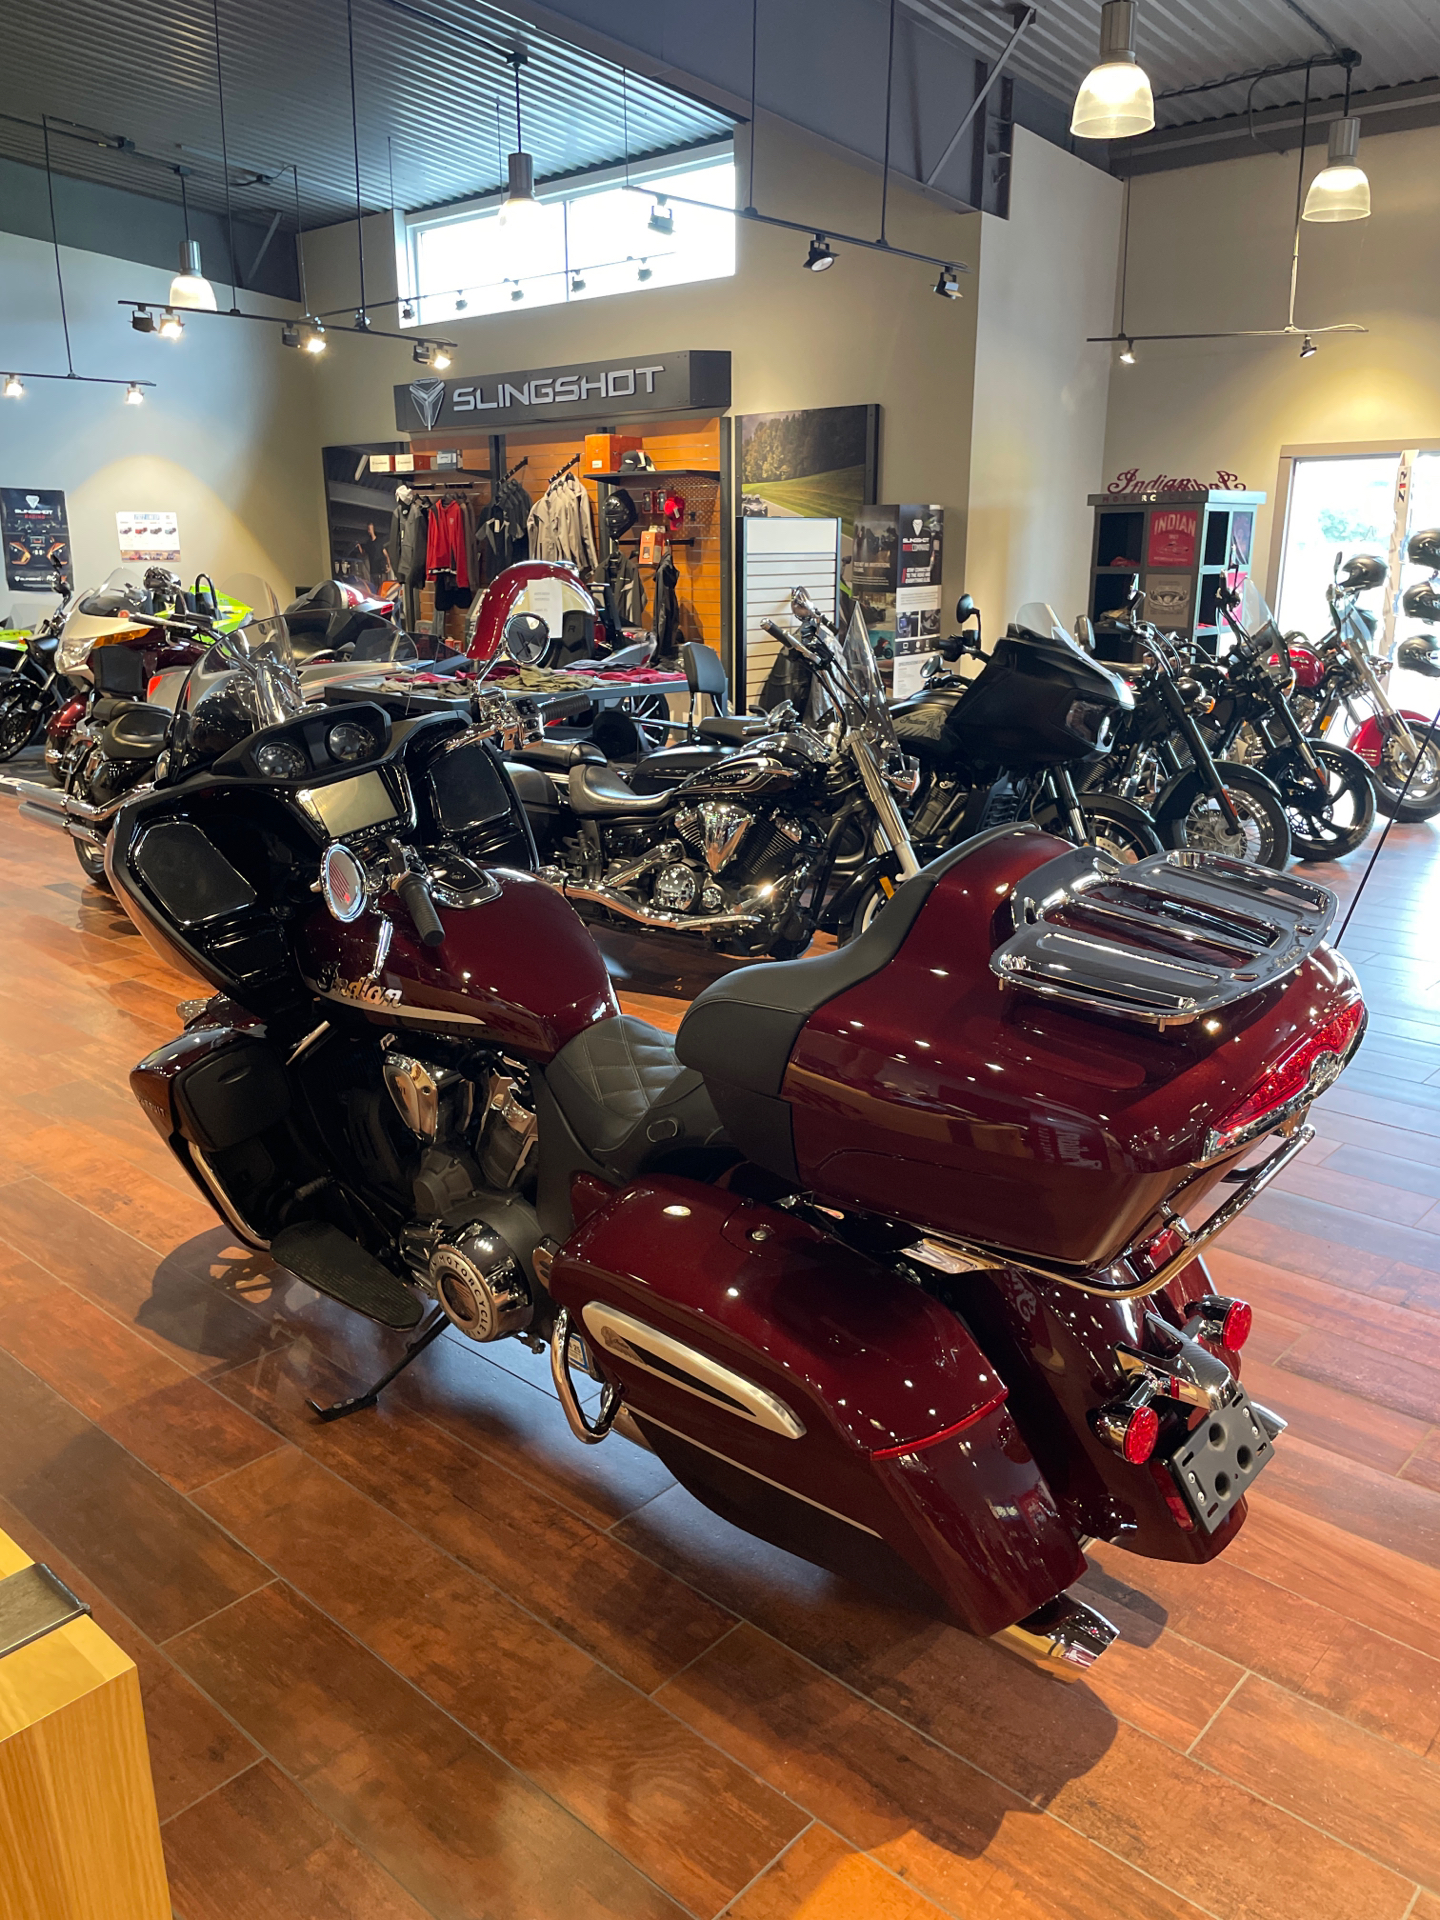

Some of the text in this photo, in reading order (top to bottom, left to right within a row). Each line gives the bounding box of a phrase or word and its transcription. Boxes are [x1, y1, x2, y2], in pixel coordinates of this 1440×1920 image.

[453, 365, 665, 412] SLINGSHOT
[1107, 468, 1191, 494] Indian
[1154, 513, 1197, 538] INDIAN
[315, 960, 403, 1009] Indian
[438, 1254, 489, 1335] MOTORCYCLE
